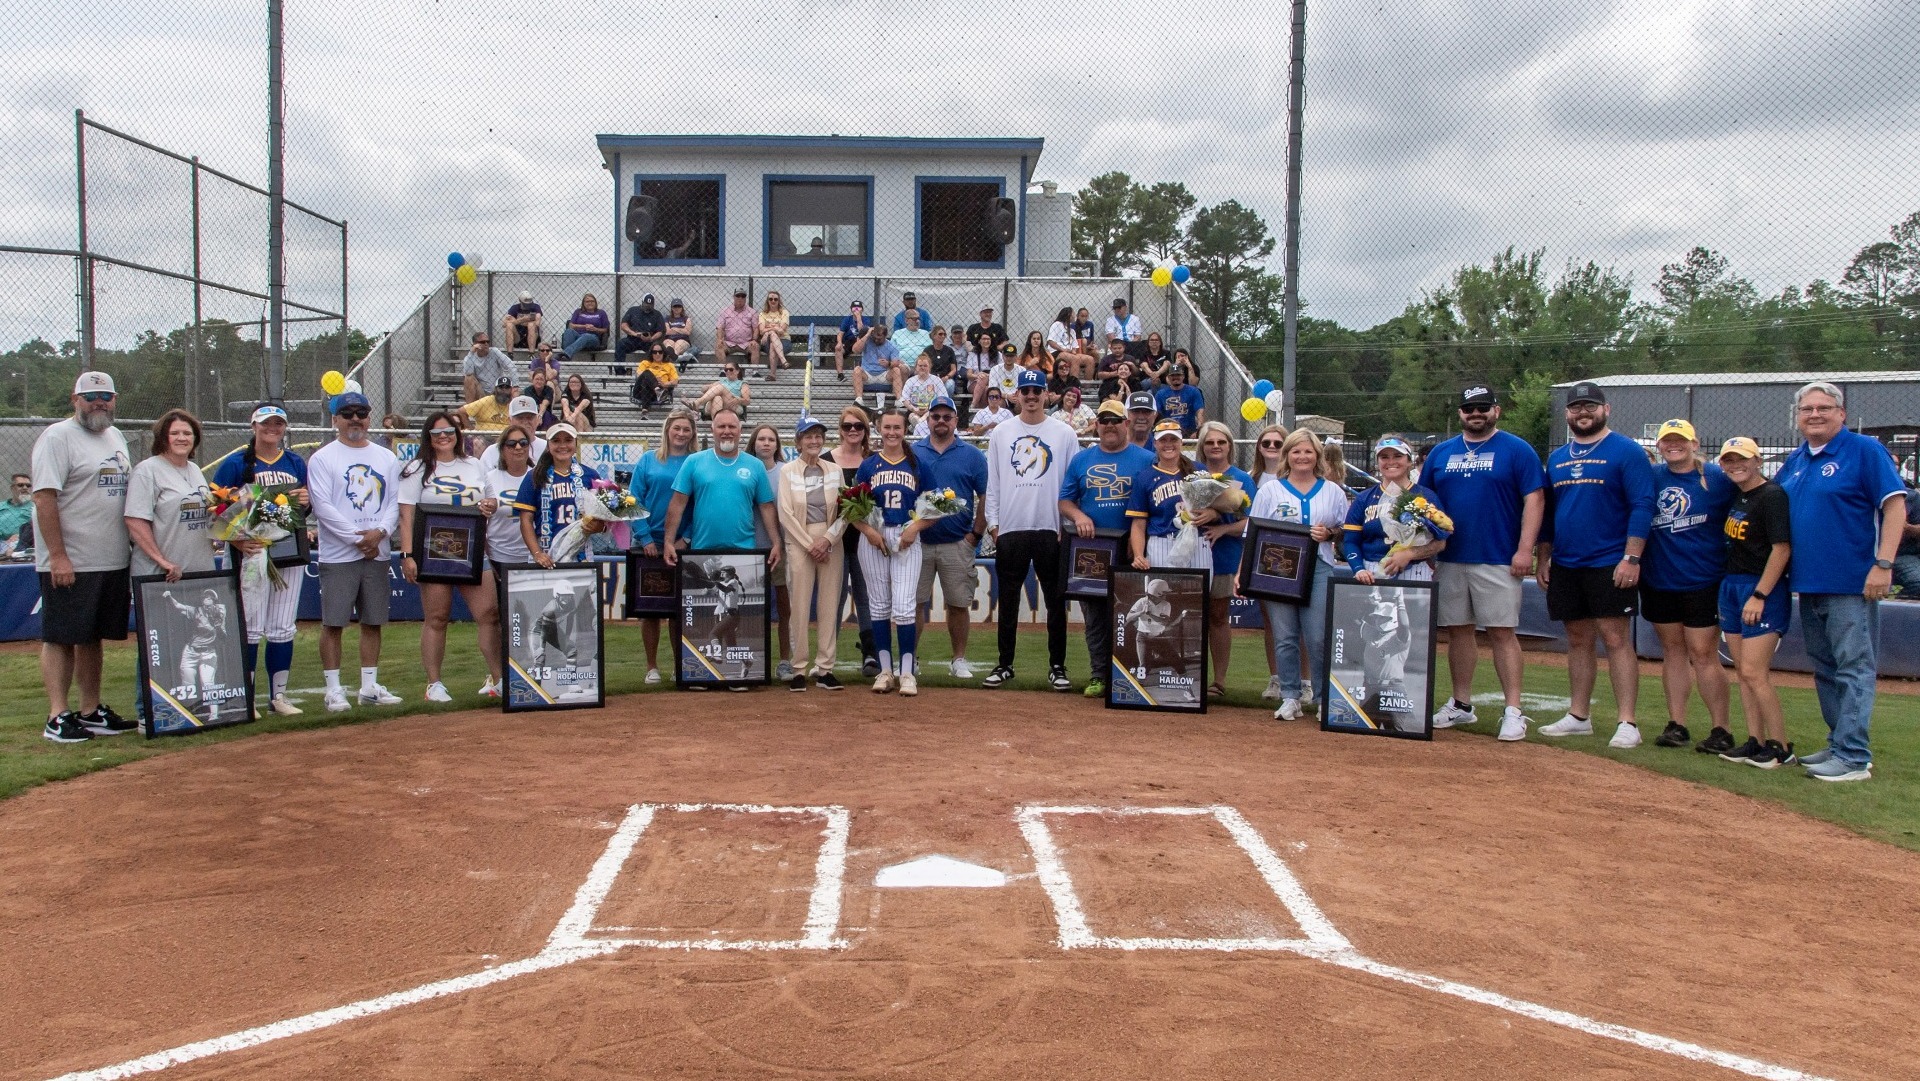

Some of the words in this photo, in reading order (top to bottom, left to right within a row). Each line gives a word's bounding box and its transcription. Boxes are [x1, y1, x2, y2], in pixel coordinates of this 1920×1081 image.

[593, 444, 630, 463] SAGE
[1446, 460, 1493, 469] SOUTHEASTERN
[870, 470, 916, 492] SOUTHEASTERN
[1086, 463, 1132, 500] SE
[884, 489, 902, 509] 12
[558, 504, 576, 524] 13
[685, 595, 693, 627] 2024-25
[1117, 614, 1125, 647] 2023-25
[150, 629, 160, 667] 2023-25
[698, 644, 722, 657] #12
[1335, 628, 1344, 664] 2022-25
[726, 651, 754, 660] CHEEK
[527, 666, 552, 680] #13
[557, 672, 597, 680] RODRIGUEZ
[1129, 666, 1147, 680] #8
[1159, 675, 1194, 685] HARLOW
[169, 685, 197, 700] #32
[202, 686, 246, 701] MORGAN
[1347, 686, 1366, 701] #3
[1379, 697, 1414, 708] SANDS
